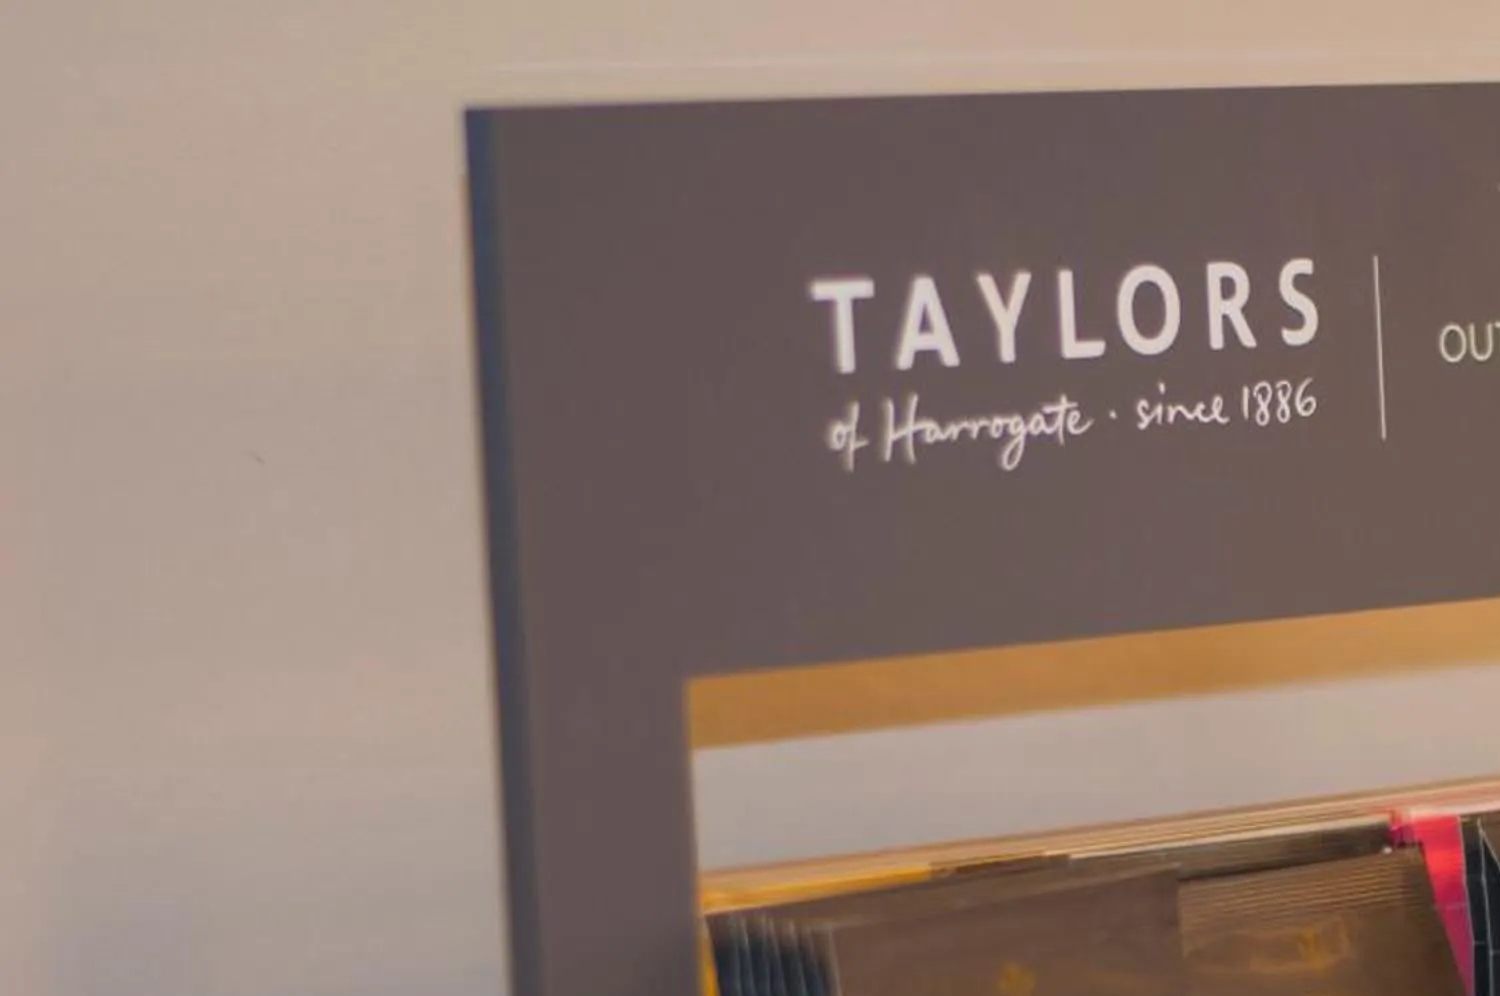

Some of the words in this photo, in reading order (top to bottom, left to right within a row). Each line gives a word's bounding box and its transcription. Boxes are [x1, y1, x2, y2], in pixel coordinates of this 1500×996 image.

[810, 258, 1319, 374] TAYLORS
[827, 400, 868, 470] of
[883, 394, 1094, 470] Harrogate
[1137, 382, 1229, 429] since
[1241, 378, 1317, 426] 1886
